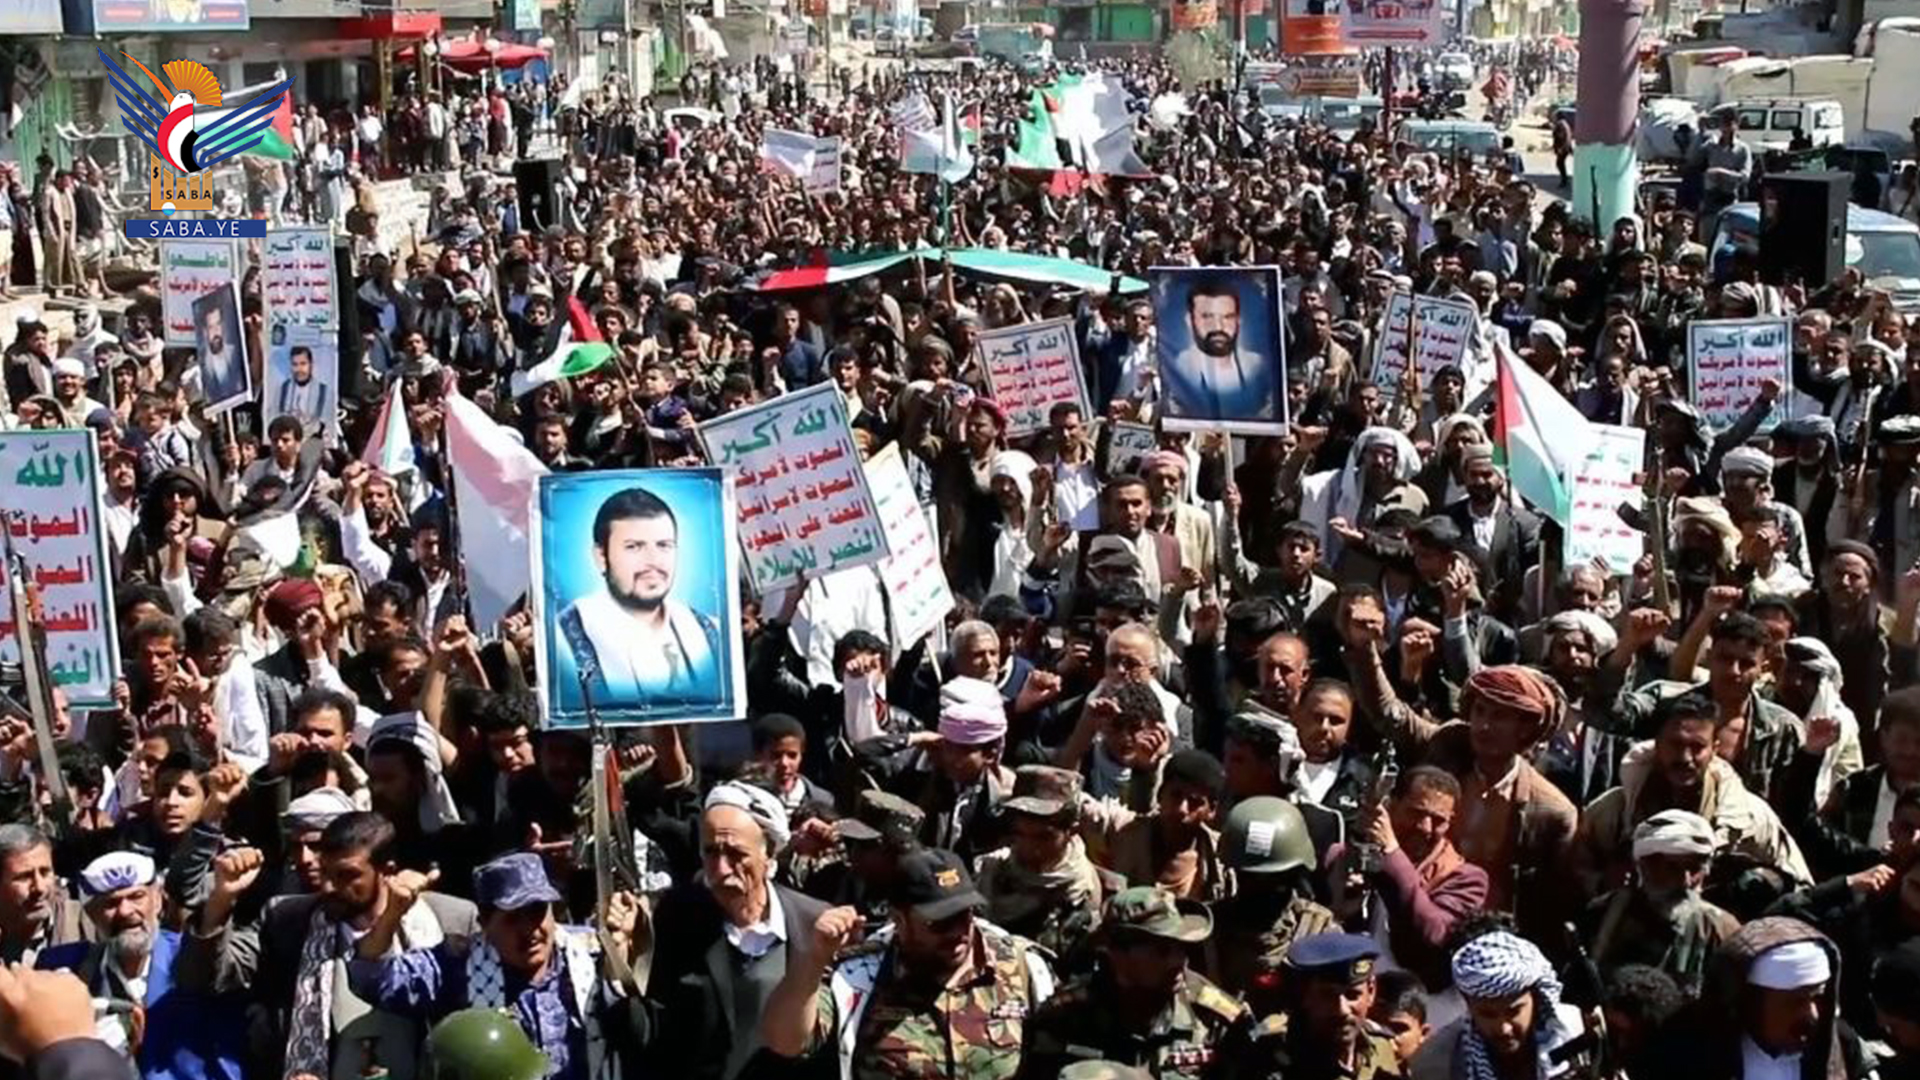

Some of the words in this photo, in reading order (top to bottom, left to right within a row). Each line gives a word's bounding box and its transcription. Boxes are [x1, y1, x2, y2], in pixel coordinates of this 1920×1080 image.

[1037, 332, 1066, 350] الله
[1752, 328, 1783, 347] الله
[793, 402, 840, 436] الله
[16, 442, 84, 487] الله
[794, 437, 850, 471] الموت
[804, 467, 861, 500] الموت
[796, 514, 821, 539] على
[828, 496, 872, 525] اللعنة
[829, 526, 881, 570] النصر
[36, 555, 93, 592] المو
[48, 643, 103, 684] النص
